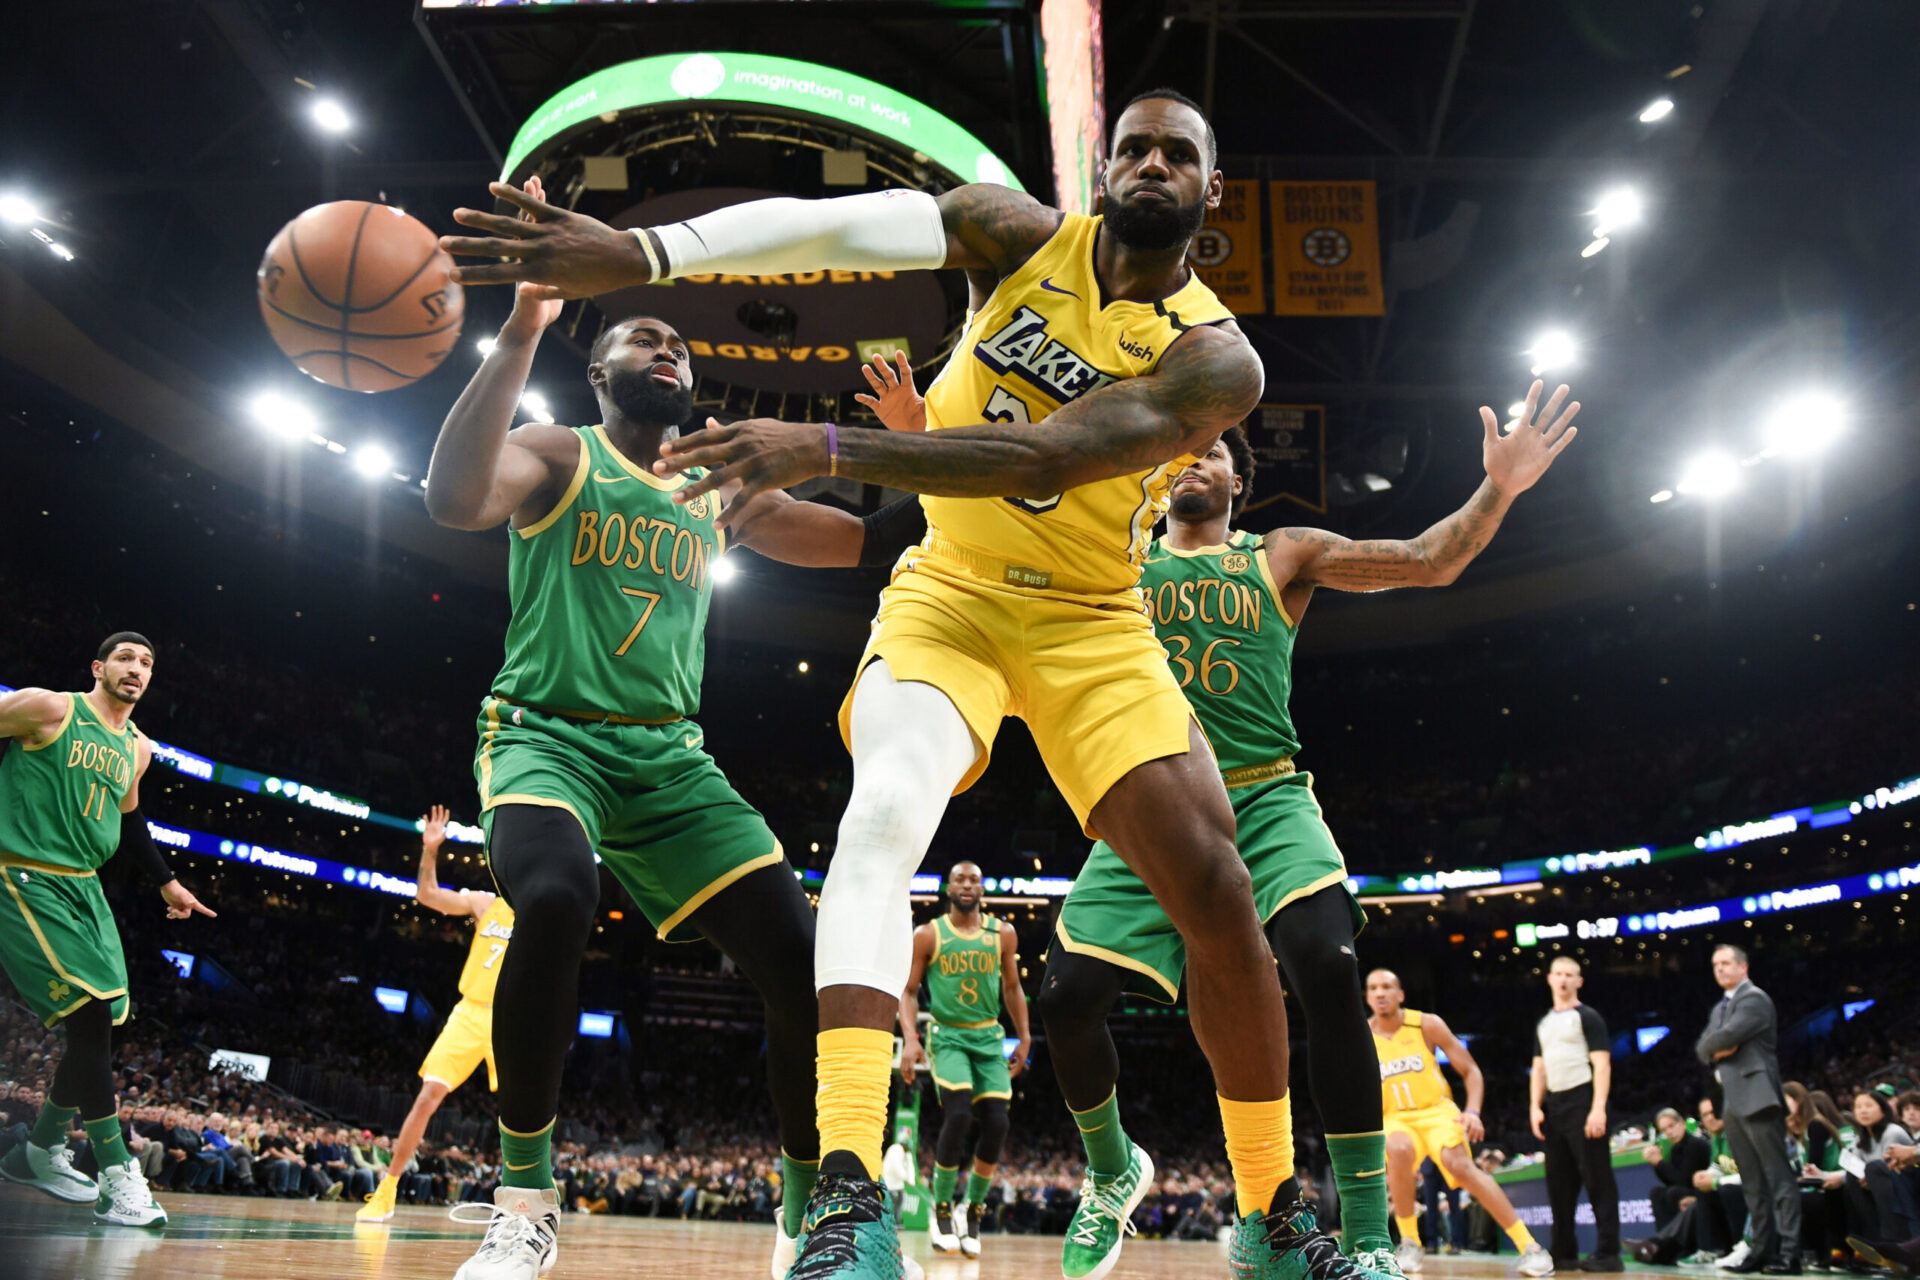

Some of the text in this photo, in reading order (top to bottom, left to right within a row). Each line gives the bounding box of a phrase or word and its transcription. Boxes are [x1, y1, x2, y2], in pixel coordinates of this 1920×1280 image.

[734, 69, 911, 128] imagination at work
[1283, 185, 1364, 202] BOSTON
[1284, 204, 1364, 223] BRUINS
[1288, 285, 1370, 297] CHAMPIONS
[687, 339, 850, 361] GARDE
[974, 304, 1121, 404] LAKE
[1118, 330, 1154, 362] wish
[571, 510, 712, 593] BOSTON
[1008, 570, 1047, 586] DR. BUSS
[612, 585, 662, 657] 7
[1162, 635, 1243, 696] 36
[67, 740, 131, 792] BOSTON
[82, 782, 108, 821] 11
[251, 846, 317, 876] Putnam
[1771, 884, 1841, 910] Putnam
[1657, 906, 1720, 930] Putnam
[484, 944, 504, 969] 7
[939, 950, 996, 977] BOSTON
[958, 977, 979, 1005] 8
[1390, 1081, 1418, 1111] 11
